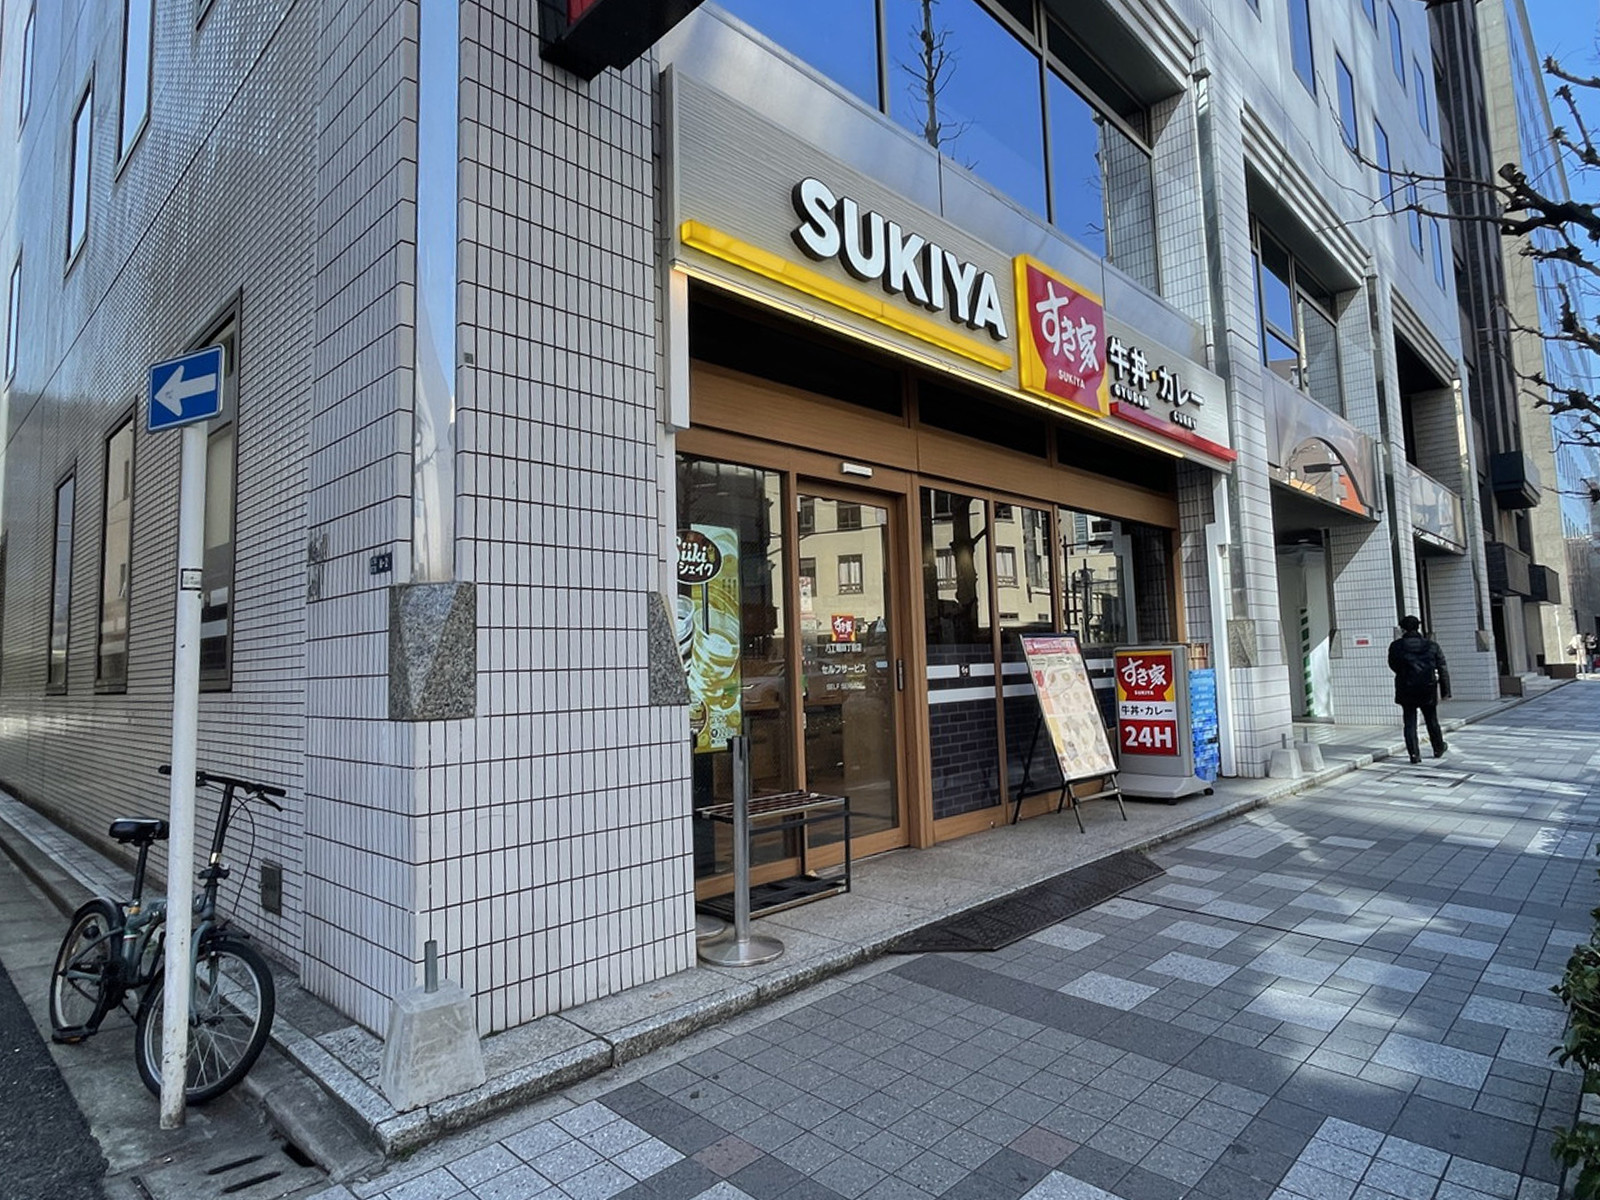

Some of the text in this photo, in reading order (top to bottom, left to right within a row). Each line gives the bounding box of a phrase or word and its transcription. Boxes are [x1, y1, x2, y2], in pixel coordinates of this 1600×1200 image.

[792, 177, 1009, 341] SUKIYA
[1036, 281, 1099, 373] すき家
[1058, 369, 1086, 389] SUKIYA
[1107, 335, 1204, 407] 牛丼・カレー
[679, 562, 713, 576] シェイク
[821, 663, 867, 675] セルフサービス
[1121, 657, 1167, 689] すき家
[1121, 705, 1173, 716] 牛丼・カレー
[1125, 725, 1173, 748] 24H
